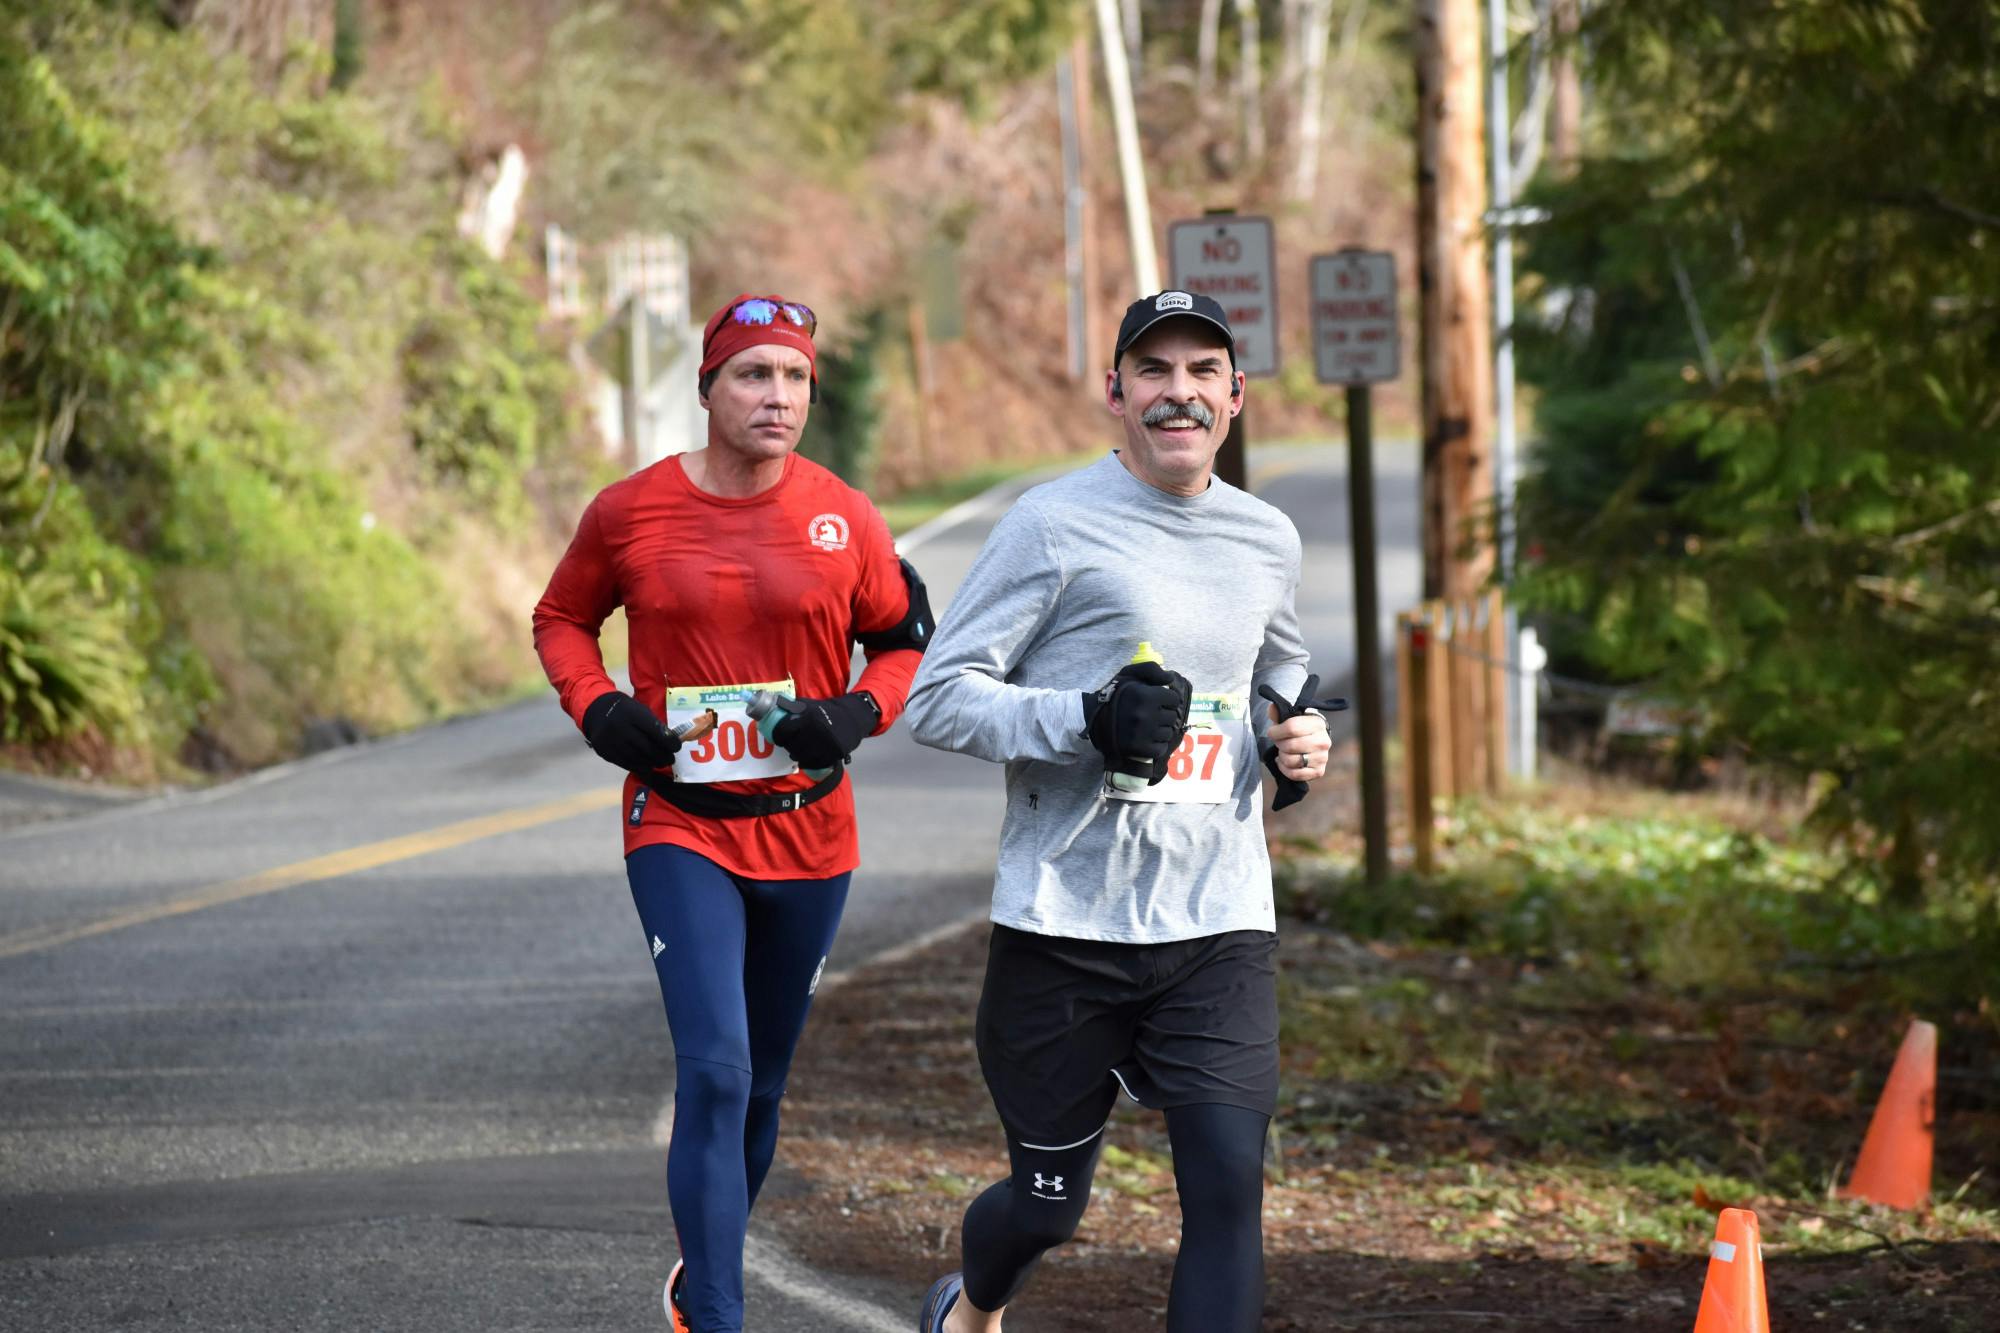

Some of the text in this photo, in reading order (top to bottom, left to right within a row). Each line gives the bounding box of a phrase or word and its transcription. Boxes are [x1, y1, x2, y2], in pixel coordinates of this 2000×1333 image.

[1201, 238, 1241, 262] NO
[1184, 273, 1262, 294] PARKING
[1333, 269, 1372, 290] NO
[1161, 300, 1187, 308] BBM
[690, 720, 775, 764] 300
